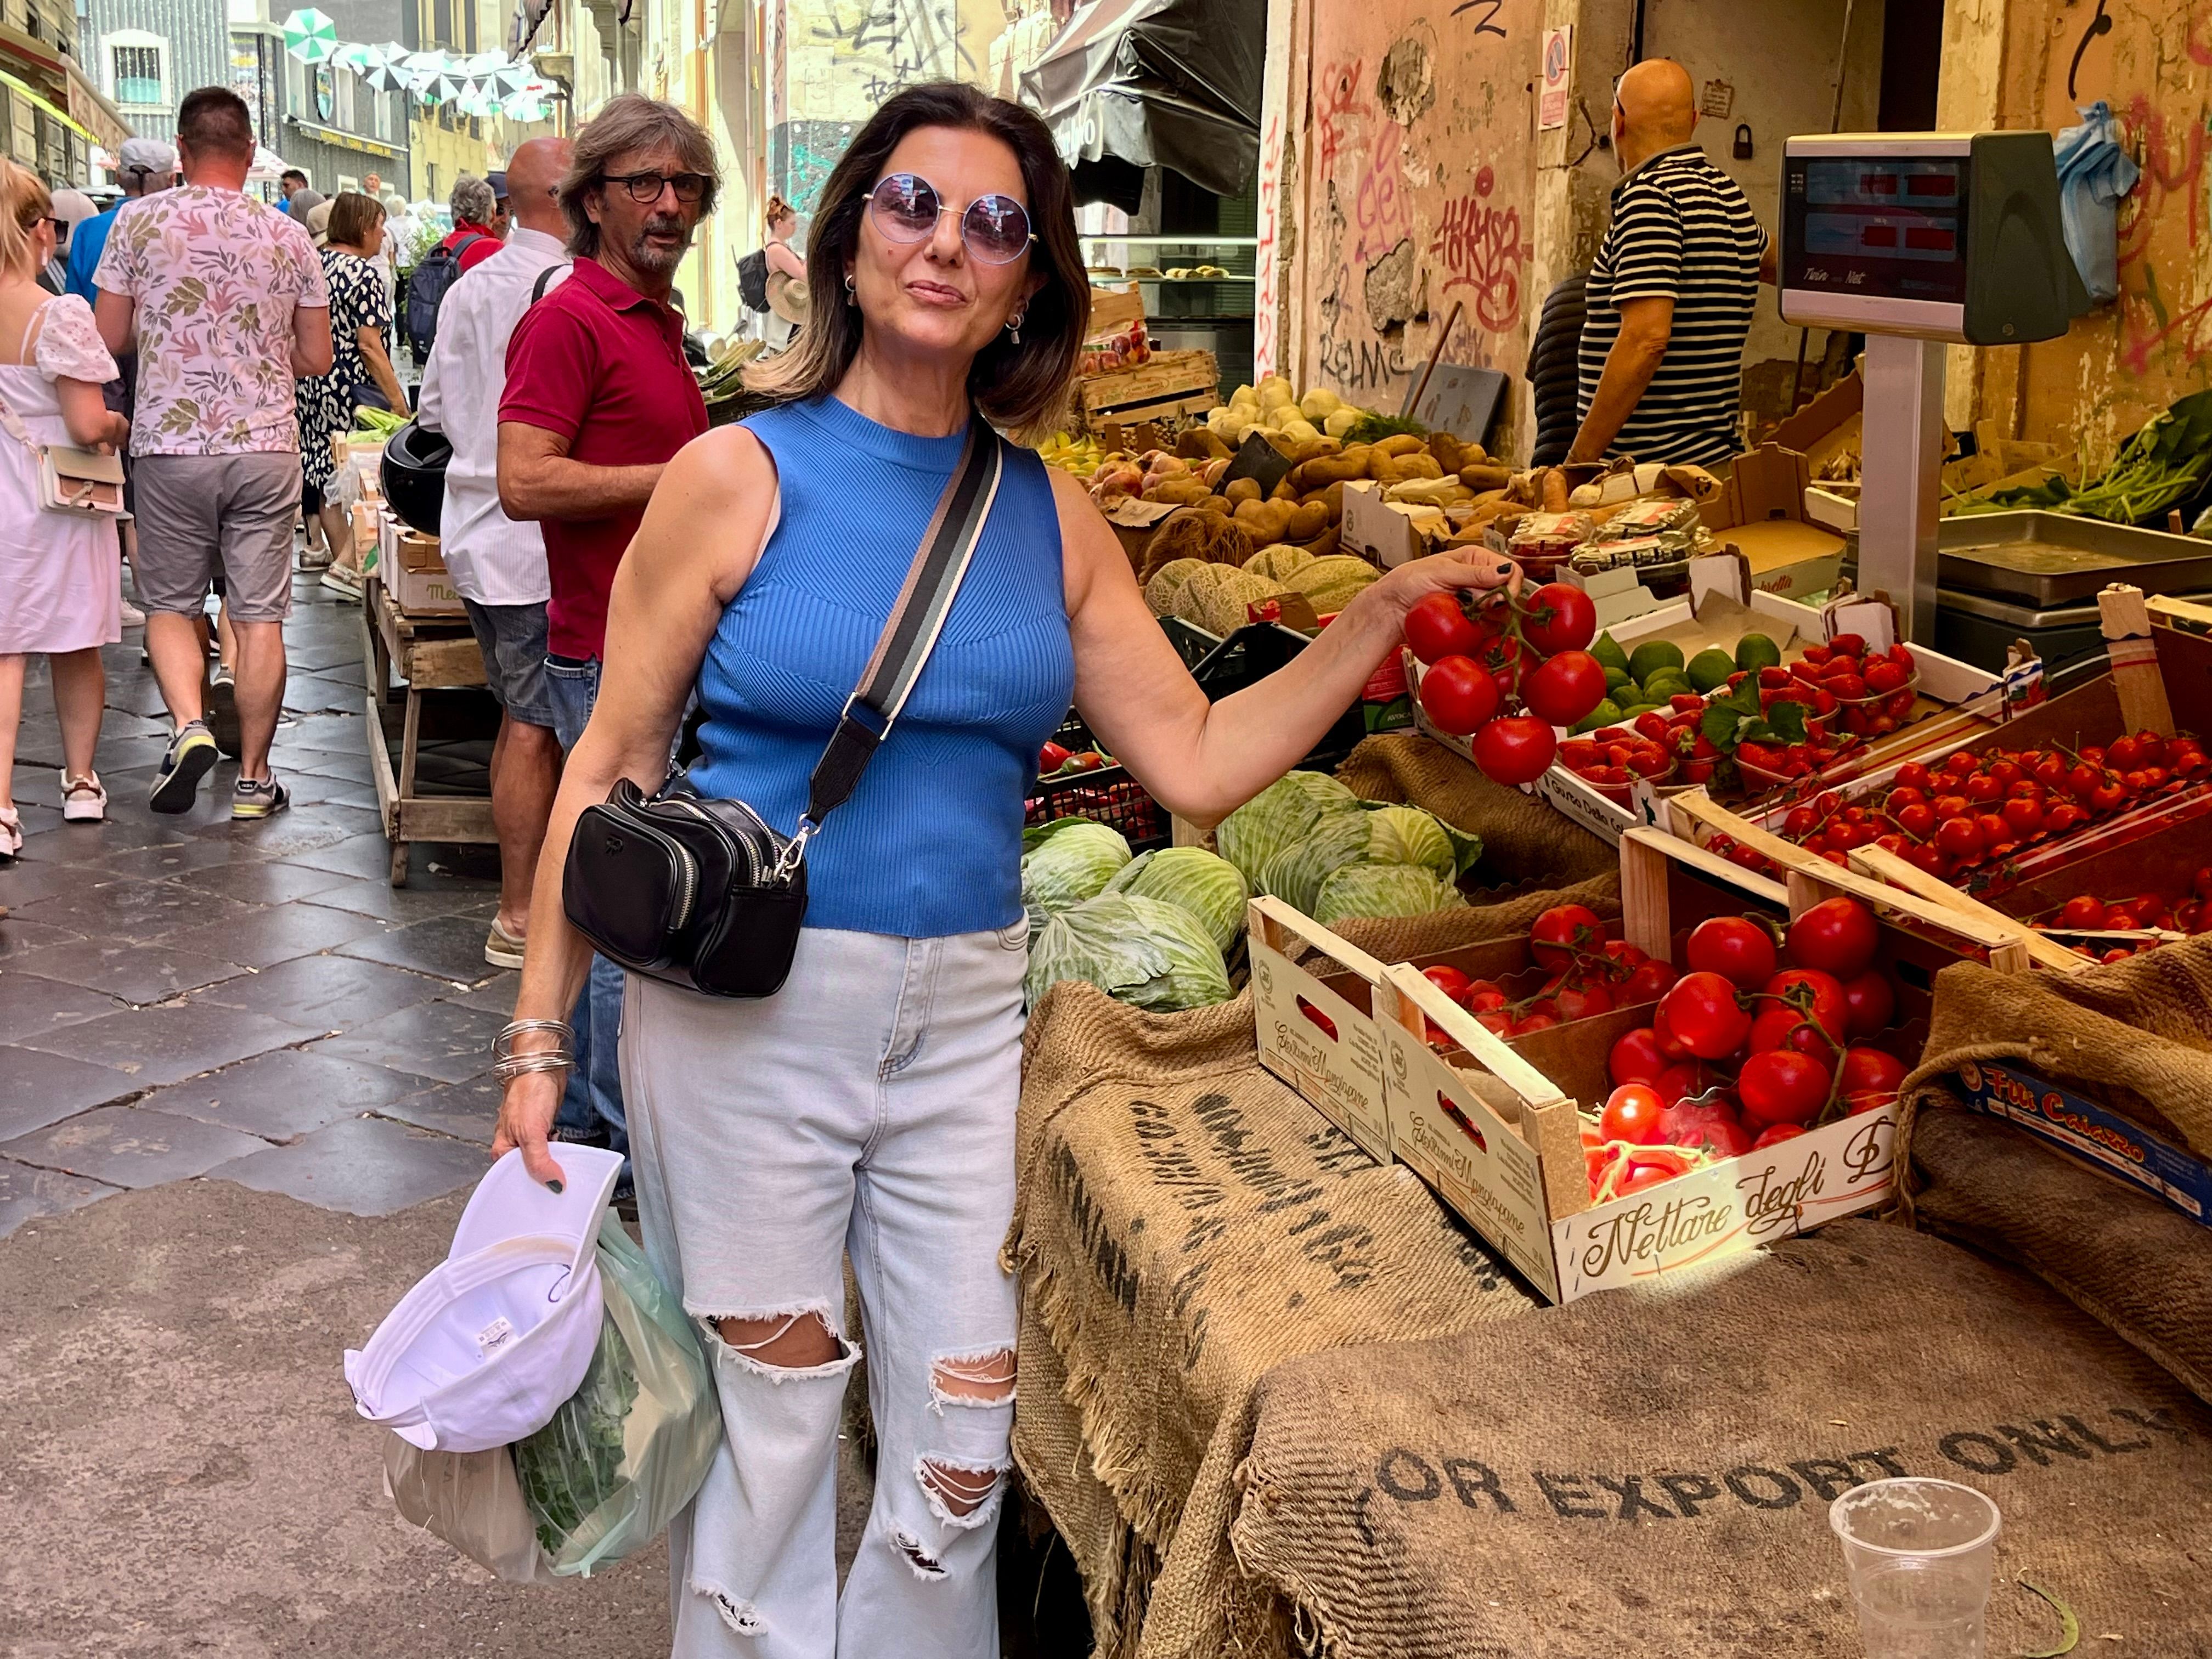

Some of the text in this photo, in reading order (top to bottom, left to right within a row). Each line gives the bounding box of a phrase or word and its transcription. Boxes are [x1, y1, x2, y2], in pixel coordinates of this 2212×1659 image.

[2042, 1092, 2146, 1163] Caiazzo
[1454, 1148, 1525, 1233] Mangiapane
[1583, 1196, 1733, 1278] Nettare
[1735, 1152, 1826, 1235] degli
[1531, 1445, 1908, 1520] EXPORT
